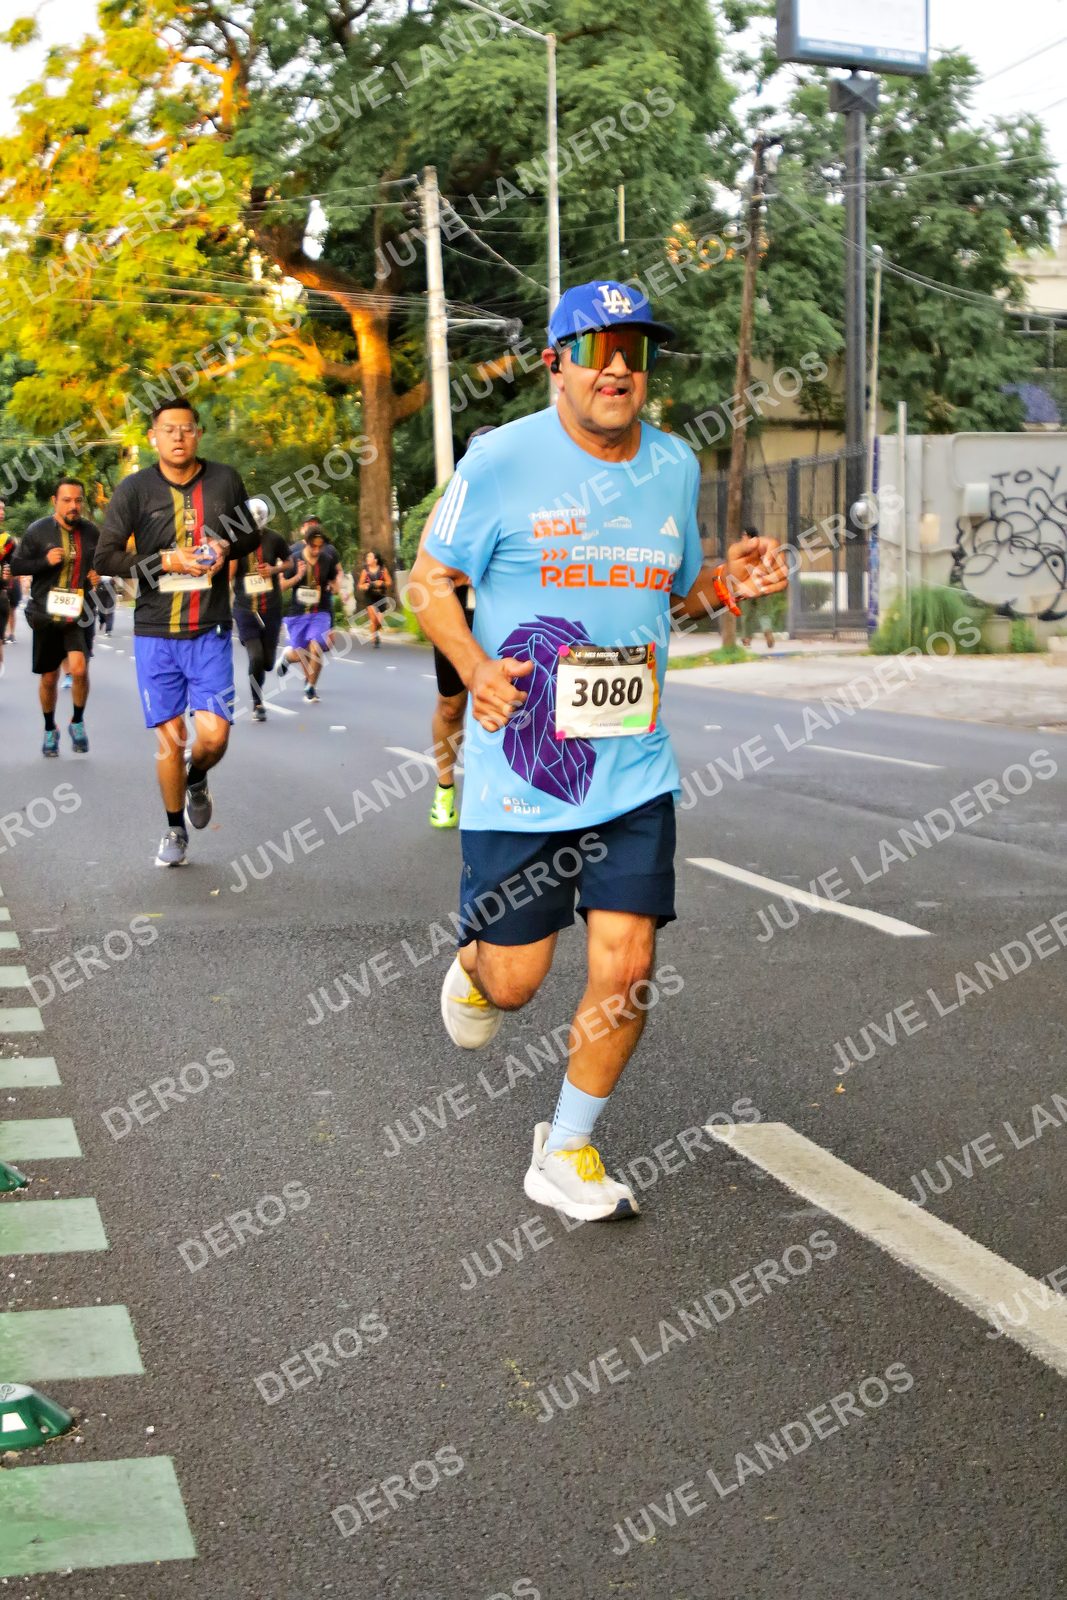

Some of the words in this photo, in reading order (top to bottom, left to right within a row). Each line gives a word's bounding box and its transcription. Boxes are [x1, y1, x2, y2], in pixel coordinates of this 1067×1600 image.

[598, 285, 632, 314] LA
[992, 466, 1061, 492] TOY
[571, 546, 665, 566] CARRERA
[53, 595, 76, 605] 2987
[571, 677, 643, 706] 3080
